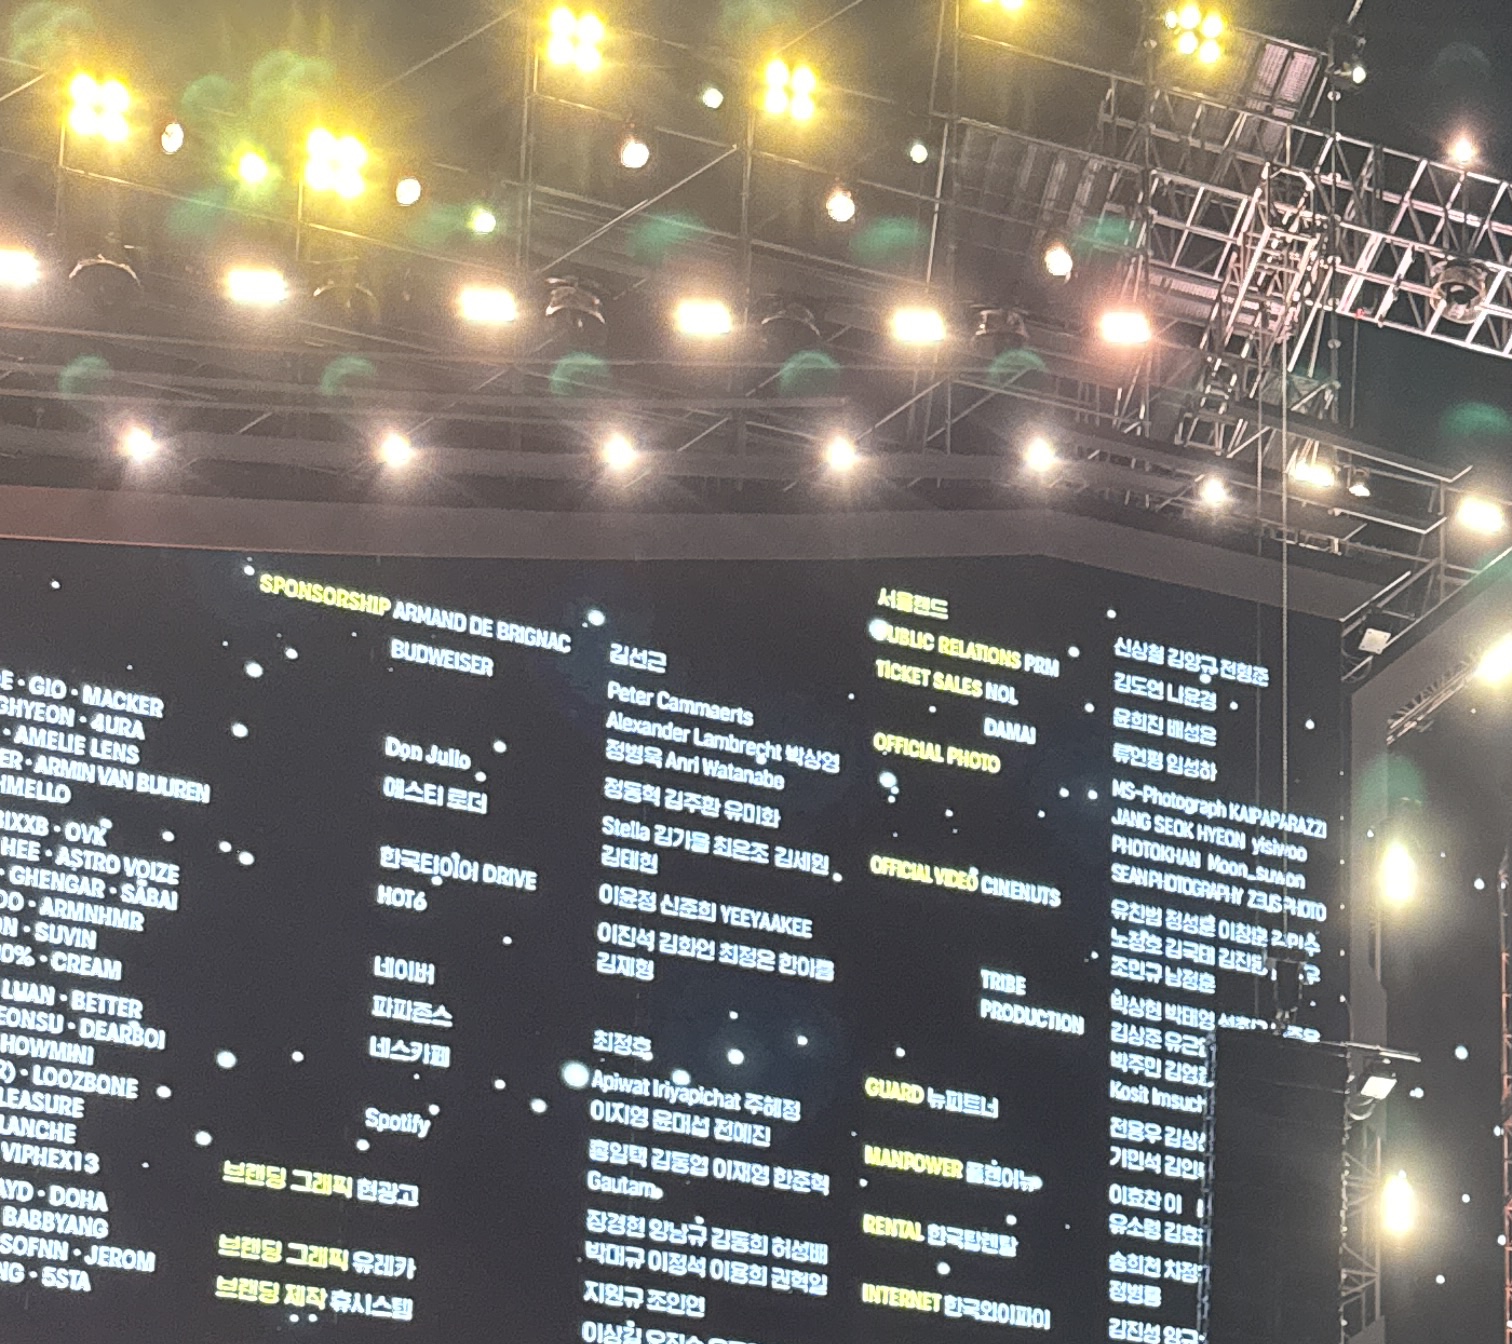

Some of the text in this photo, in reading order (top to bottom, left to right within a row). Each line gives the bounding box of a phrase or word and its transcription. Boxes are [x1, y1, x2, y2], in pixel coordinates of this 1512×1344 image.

[260, 573, 571, 653] SPONSORSHIP ARMAND DE BRIGNAC
[390, 639, 494, 677] BUDWEISER
[877, 623, 1060, 677] UBLIC RELATIONS PRM
[876, 659, 1019, 706] TICKET SALES NOL
[82, 685, 164, 718] MACKER
[607, 680, 754, 727] Peter Cammaerts
[90, 713, 145, 740] 4URA
[606, 711, 782, 762] Alexander Lambrecht
[984, 717, 1036, 744] DAMAI
[14, 725, 140, 764] AMELIE LENS
[385, 736, 471, 770] Don Julio
[873, 732, 1001, 774] OFFICIAL PHOTO
[34, 755, 210, 804] ARMIN VAN BUUREN
[665, 751, 785, 790] Anri Watanabe
[383, 776, 487, 814] 에스티 로더
[602, 816, 650, 842] Stella
[1111, 808, 1246, 850] JANG SEOK HYEON
[55, 846, 180, 885] ASTRO VOIZE
[380, 845, 538, 891] 한국타이어 DRIVE
[1112, 834, 1201, 868] PHOTOKHAN
[9, 865, 178, 910] GHENGAR SABAI
[870, 854, 932, 884] OFFICIAL
[934, 867, 978, 891] VIDEO
[1150, 868, 1244, 906] PHOTOGRAPHY
[39, 896, 145, 931] ARMNHMR
[377, 884, 428, 911] HOT6
[34, 922, 97, 949] SUVIN
[50, 951, 122, 981] CREAM
[374, 955, 435, 985] 네이버
[981, 968, 1026, 996] TRIBE
[70, 989, 143, 1019] BETTER
[372, 995, 453, 1027] 파파존스
[980, 998, 1084, 1035] PRODUCTION
[370, 1035, 450, 1067] 네스카페
[33, 1065, 139, 1099] LOOZBONE
[592, 1069, 650, 1096] Apiwat
[865, 1077, 924, 1104] GUARD
[365, 1107, 431, 1138] Spotify
[1, 1141, 100, 1174] VIPHEX13
[865, 1145, 963, 1179] MANPOWER
[223, 1160, 352, 1199] 브랜딩 그래픽
[49, 1185, 109, 1212] DOHA
[2, 1205, 109, 1238] BABBYANG
[863, 1213, 925, 1242] RENTAL
[84, 1246, 156, 1272] JEROM
[218, 1234, 282, 1263] 브랜딩
[286, 1243, 349, 1271] 그래픽
[41, 1266, 91, 1292] 5STA
[215, 1276, 279, 1304] 브랜딩
[862, 1283, 941, 1312] INTERNET
